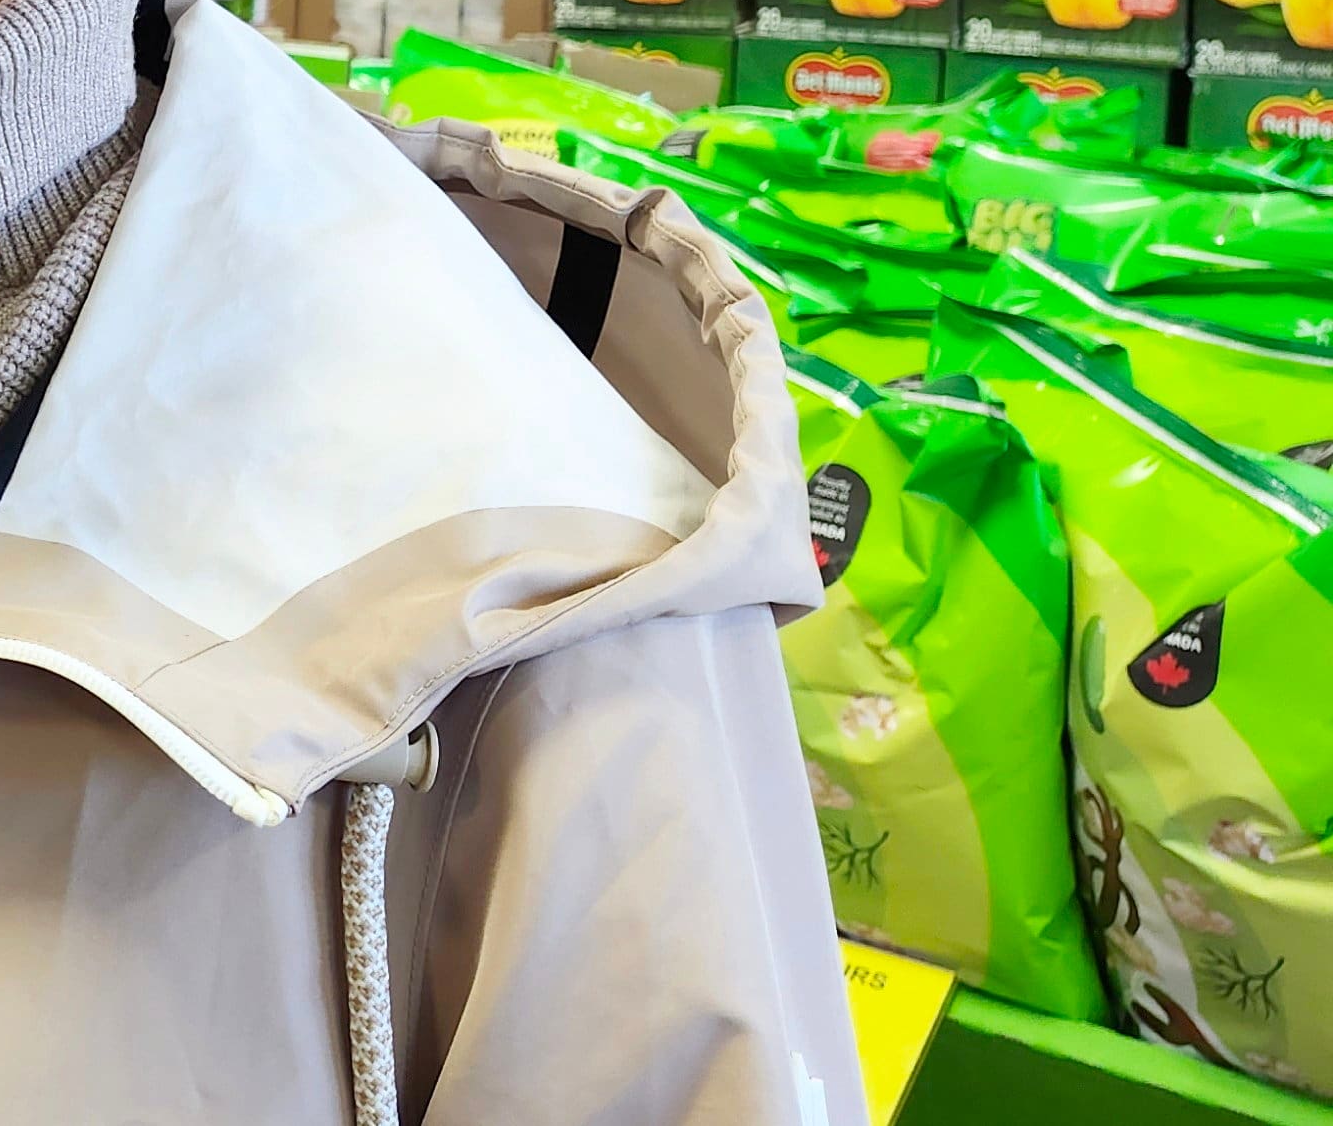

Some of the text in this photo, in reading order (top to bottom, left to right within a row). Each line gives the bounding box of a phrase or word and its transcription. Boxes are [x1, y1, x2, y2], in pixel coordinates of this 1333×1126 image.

[973, 197, 1055, 232] BIG
[811, 520, 846, 542] NADA
[844, 964, 888, 991] RS
